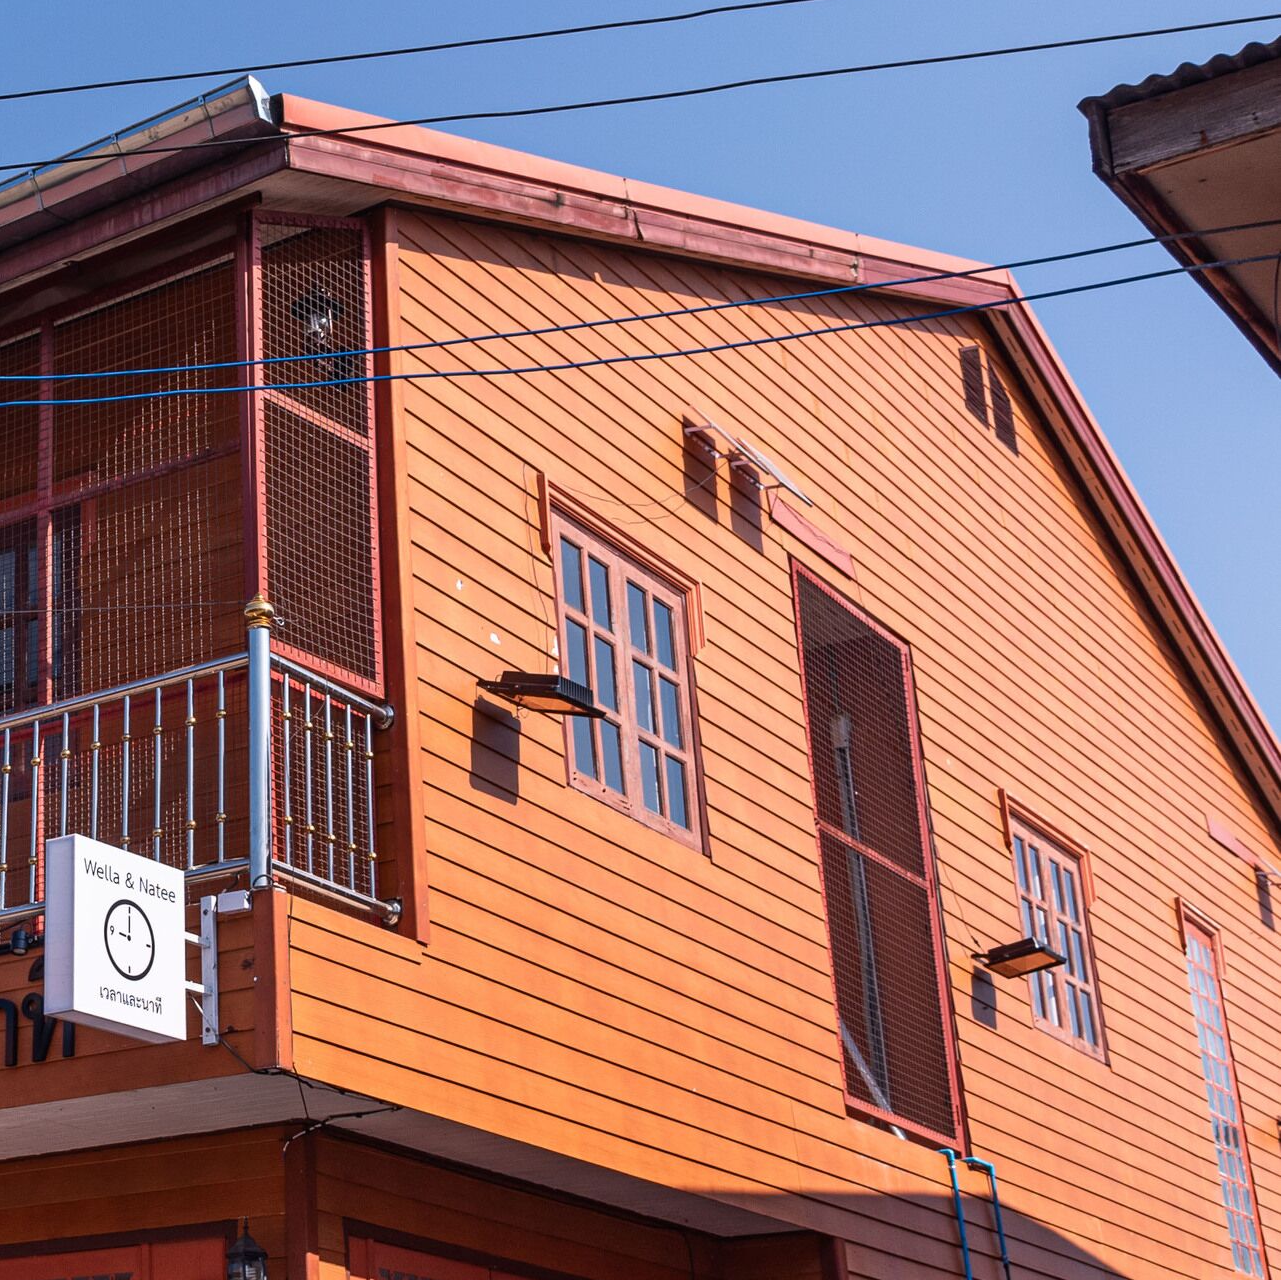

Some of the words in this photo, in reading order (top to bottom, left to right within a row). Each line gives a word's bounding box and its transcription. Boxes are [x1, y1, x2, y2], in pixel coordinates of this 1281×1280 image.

[84, 857, 120, 885] Wella
[125, 872, 135, 889] &
[139, 876, 176, 904] Natee
[109, 925, 115, 935] 9
[99, 985, 163, 1015] เวลาและนาที
